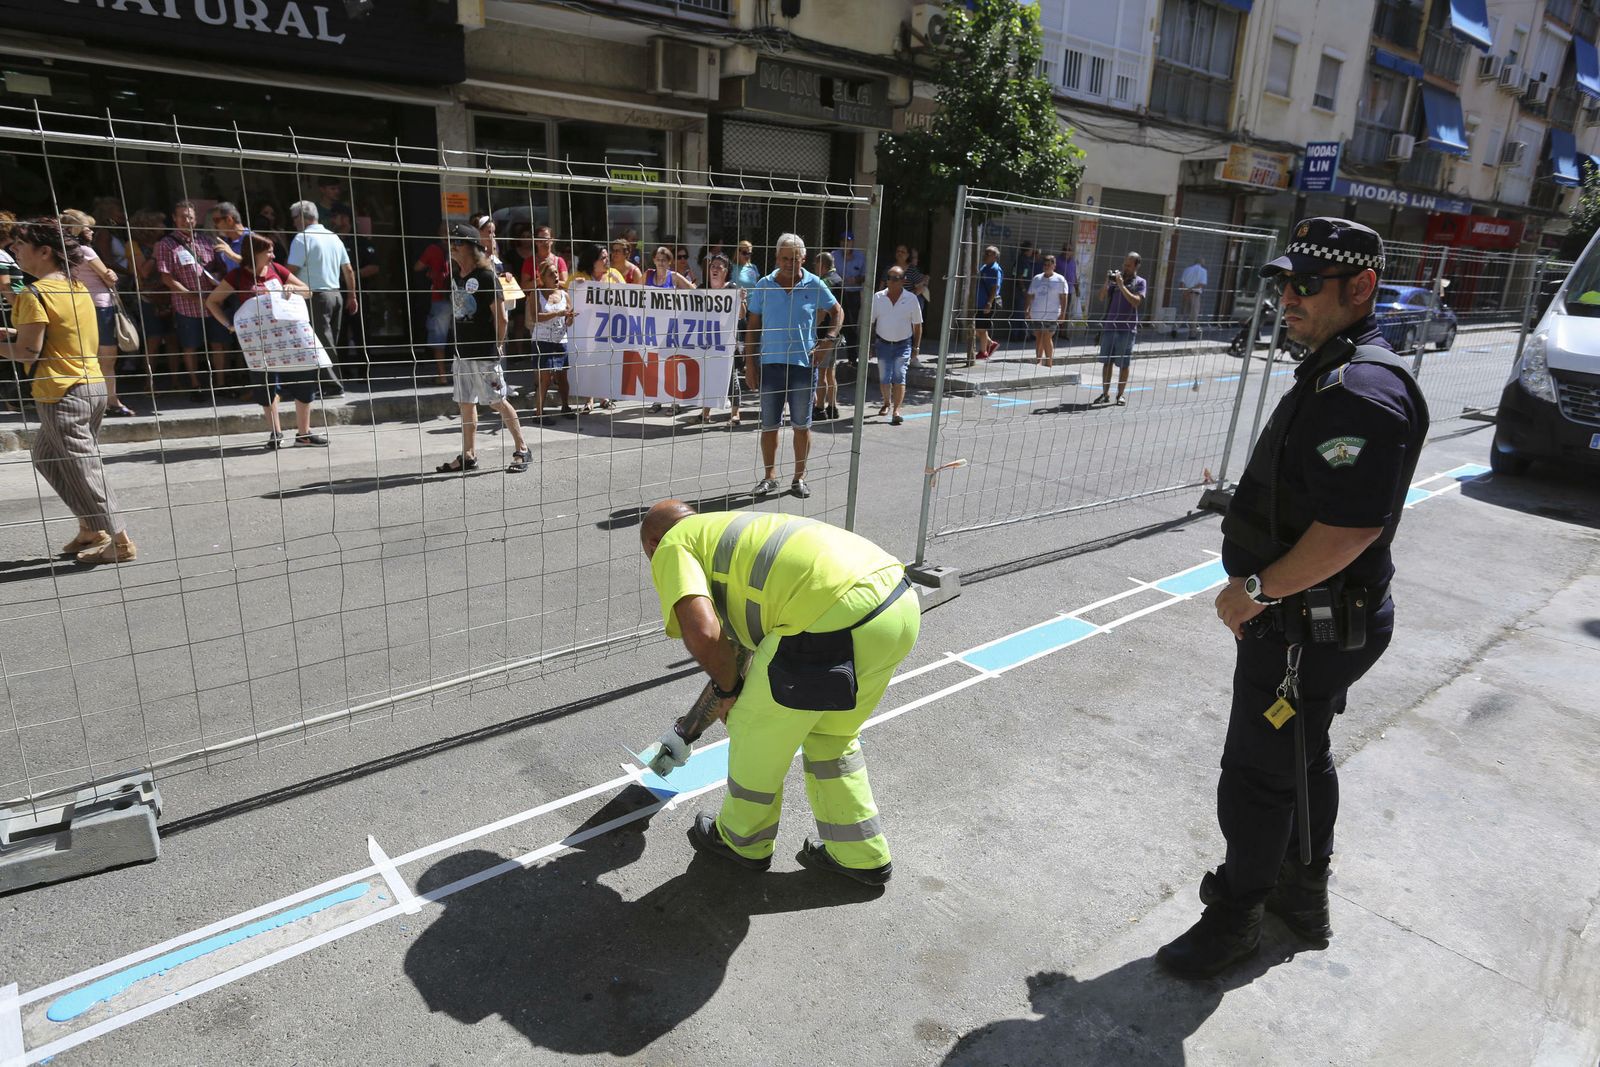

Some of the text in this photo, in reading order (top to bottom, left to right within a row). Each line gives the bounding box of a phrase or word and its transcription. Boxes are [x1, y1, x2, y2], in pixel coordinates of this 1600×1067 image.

[63, 0, 346, 44] TURAL
[1307, 145, 1338, 157] MODAS
[1309, 160, 1330, 172] LIN
[1350, 183, 1408, 205] MODAS
[1411, 194, 1436, 209] LIN
[585, 287, 733, 313] ALCALDE MENTIROSO
[594, 312, 725, 351] ZONA AZUL
[621, 350, 700, 400] NO
